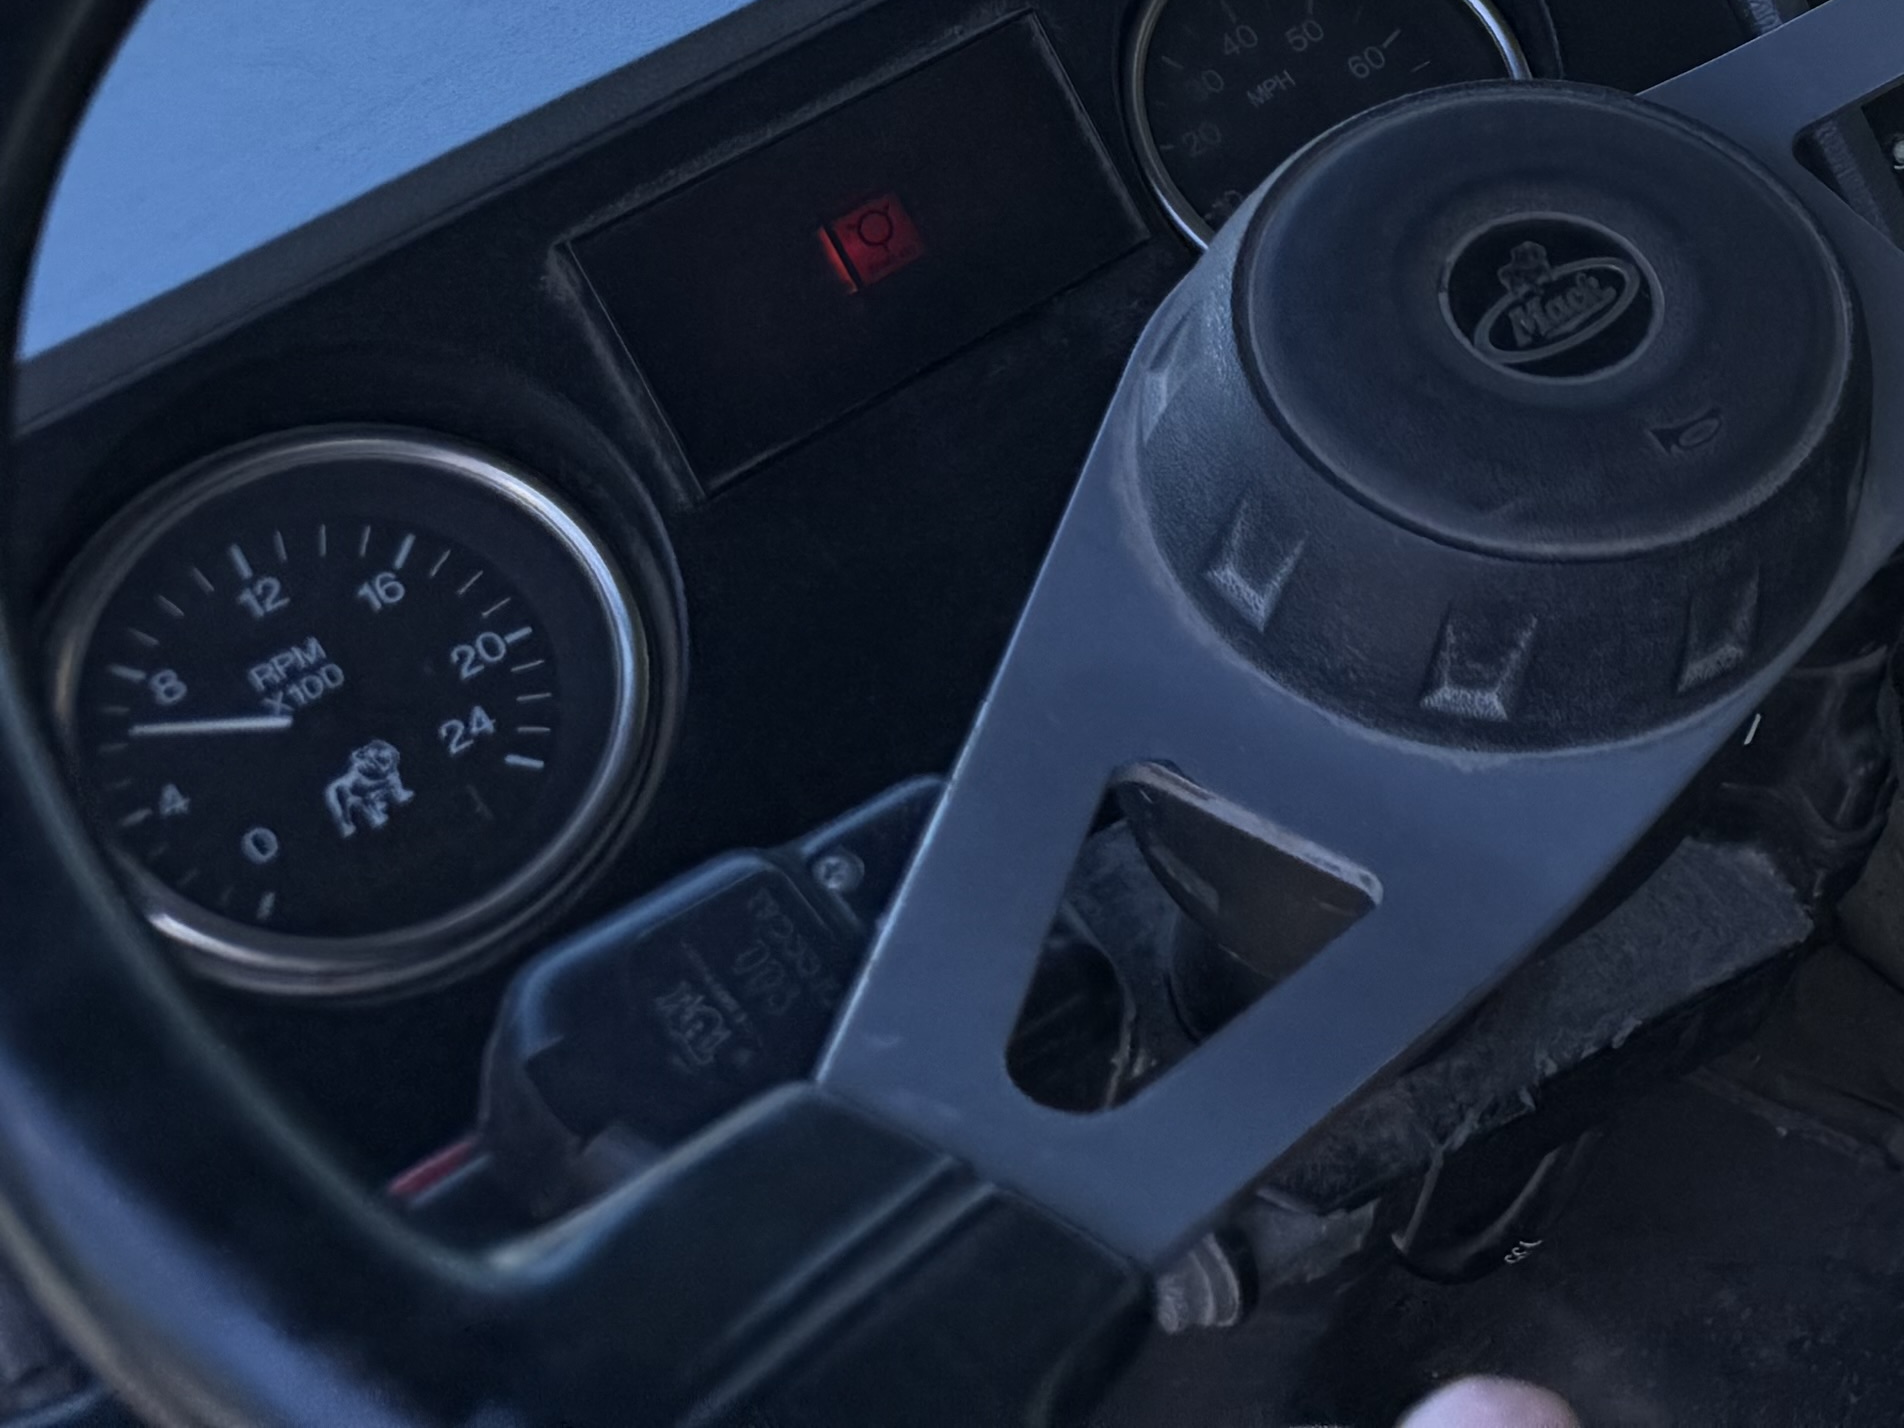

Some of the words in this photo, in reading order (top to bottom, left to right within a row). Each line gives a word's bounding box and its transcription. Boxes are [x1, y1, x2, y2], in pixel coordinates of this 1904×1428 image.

[1222, 24, 1258, 56] 40
[1284, 19, 1324, 53] 50
[1347, 46, 1386, 79] 60
[1246, 69, 1296, 108] MPH
[1181, 122, 1222, 157] 20
[1508, 272, 1617, 348] Mack
[237, 576, 291, 618] 12
[356, 571, 405, 614] 16
[248, 635, 327, 693] RPM
[450, 631, 506, 681] 20
[150, 669, 188, 705] 8
[261, 663, 345, 714] X100
[438, 705, 495, 757] 24
[158, 782, 190, 817] 4
[241, 826, 279, 864] 0
